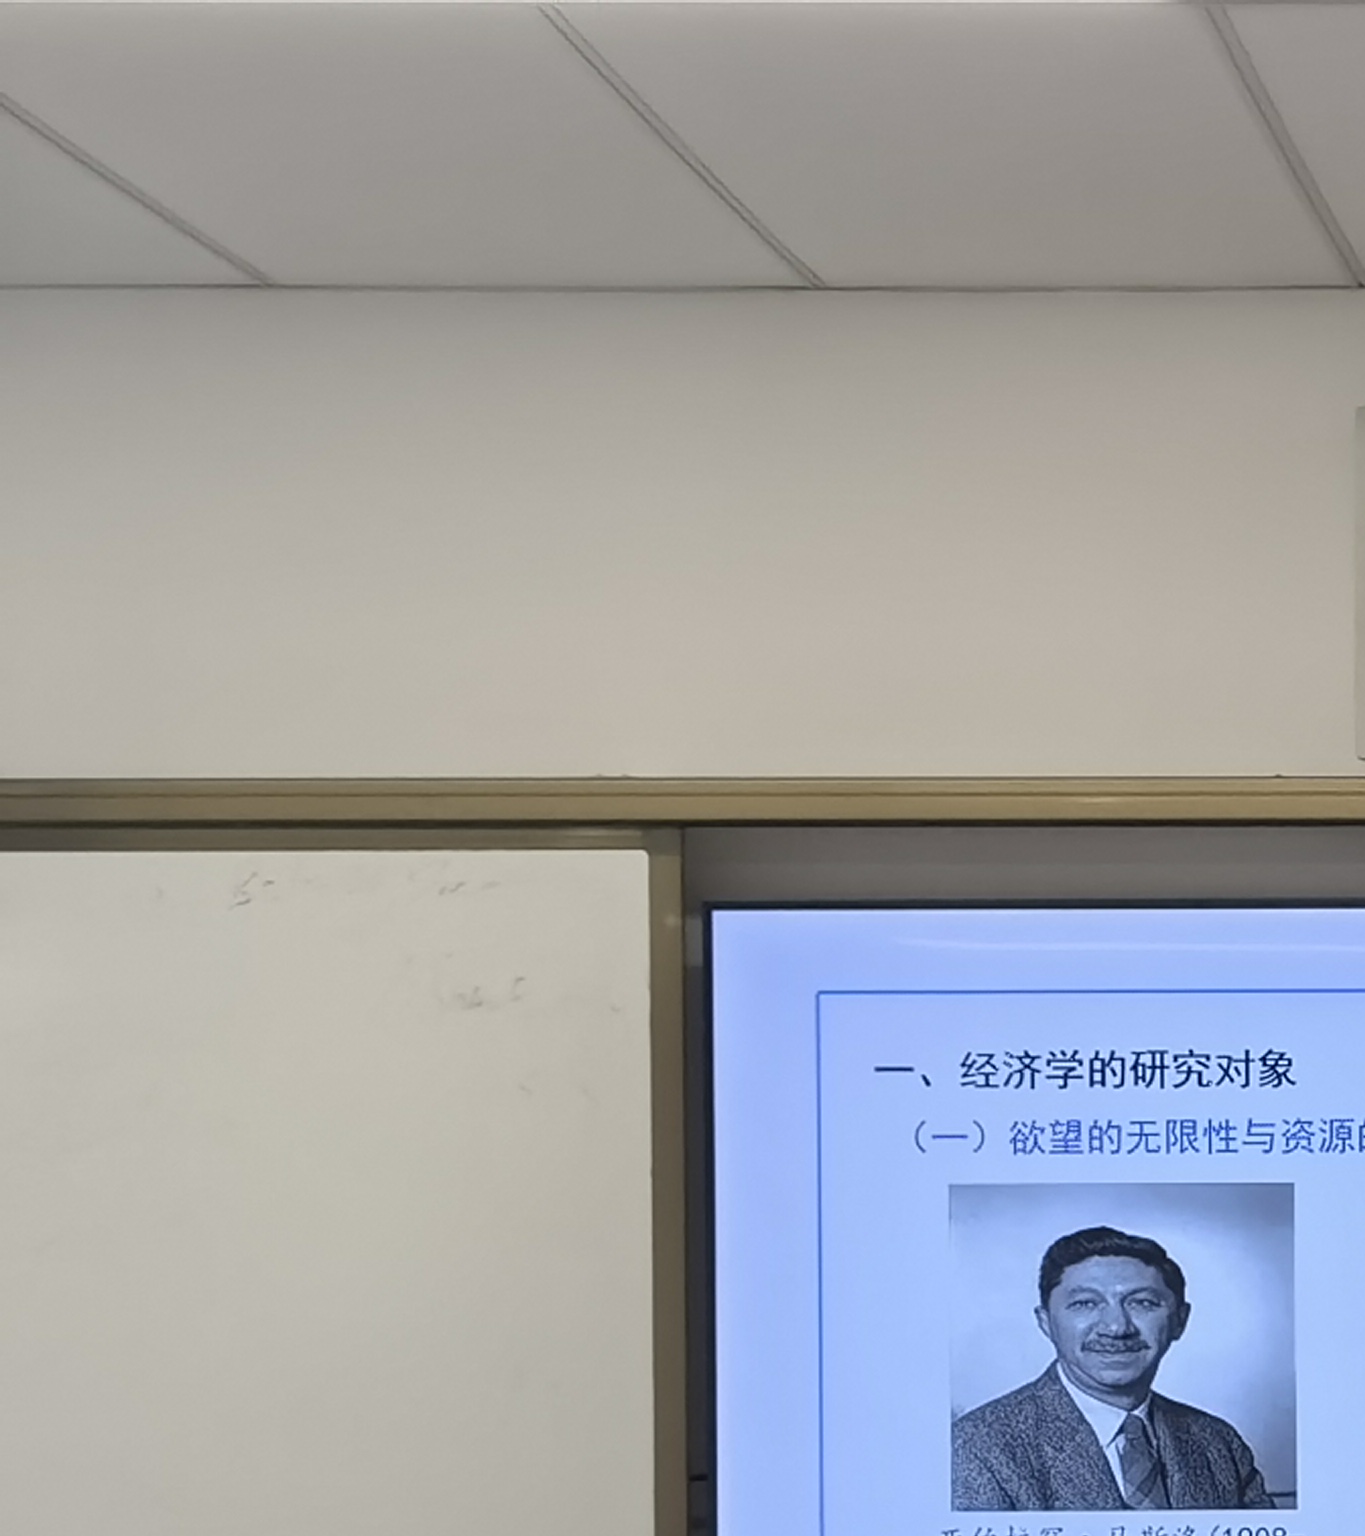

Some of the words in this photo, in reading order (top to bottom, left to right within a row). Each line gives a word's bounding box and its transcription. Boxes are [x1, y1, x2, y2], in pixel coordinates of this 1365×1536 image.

[874, 1048, 1298, 1090] 一、经济学的研究对象
